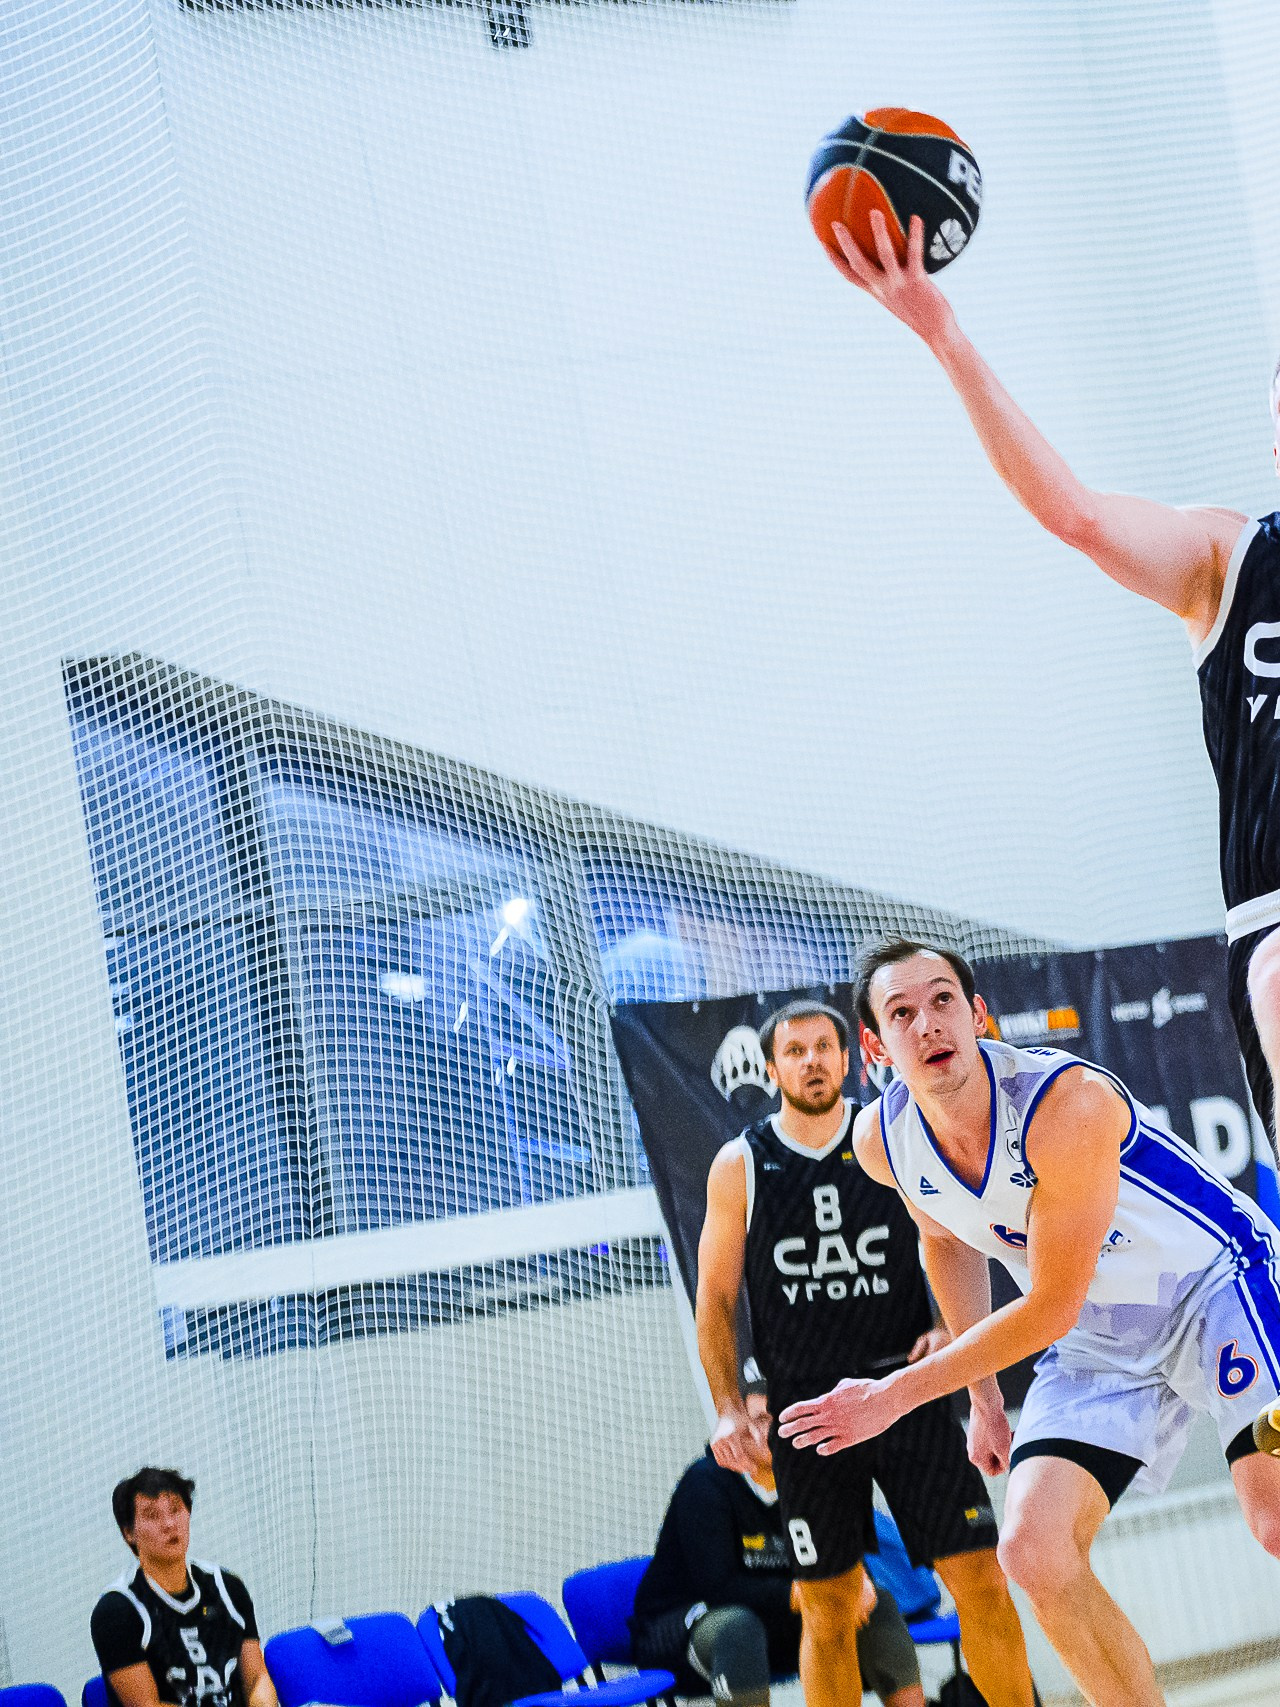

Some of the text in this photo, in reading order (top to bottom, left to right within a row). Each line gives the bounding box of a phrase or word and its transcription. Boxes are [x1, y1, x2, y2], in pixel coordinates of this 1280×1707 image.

[813, 1184, 842, 1232] 8
[773, 1224, 890, 1279] СДС
[1216, 1338, 1259, 1399] 6
[788, 1518, 818, 1567] 8
